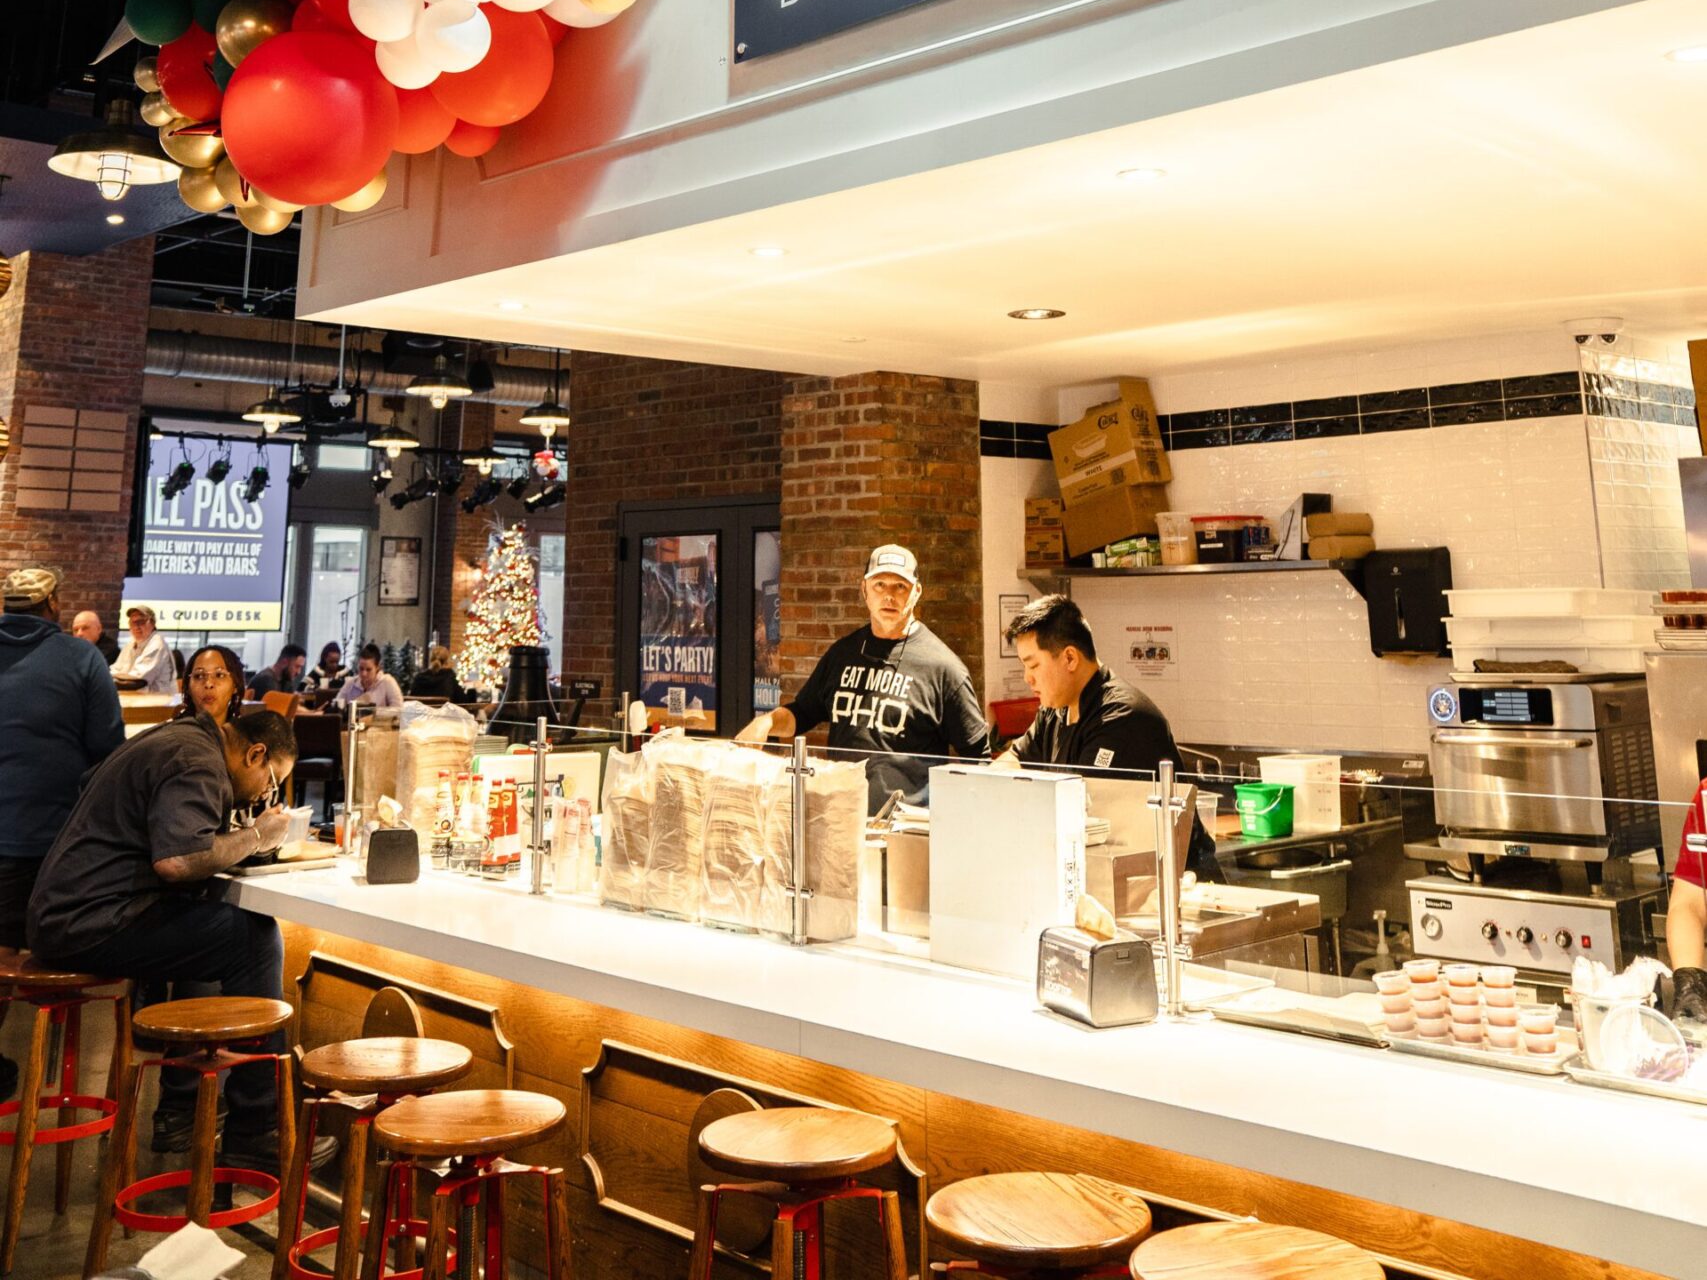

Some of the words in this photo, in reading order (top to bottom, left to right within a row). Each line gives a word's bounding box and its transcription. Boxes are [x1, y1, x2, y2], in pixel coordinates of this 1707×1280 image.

[192, 479, 264, 530] PASS
[174, 541, 194, 554] WAY
[194, 541, 206, 554] TO
[206, 542, 223, 555] PAY
[223, 542, 234, 555] AT
[234, 543, 249, 556] ALL
[250, 543, 262, 556] OF
[197, 556, 224, 575] AND
[224, 557, 260, 576] BARS.
[173, 610, 218, 620] GUIDE
[225, 611, 261, 621] DESK
[643, 645, 672, 671] LET'S
[674, 646, 714, 674] PARTY!
[754, 677, 771, 685] HALL
[840, 666, 866, 688] EAT
[865, 668, 914, 698] MORE
[832, 691, 910, 735] PHO
